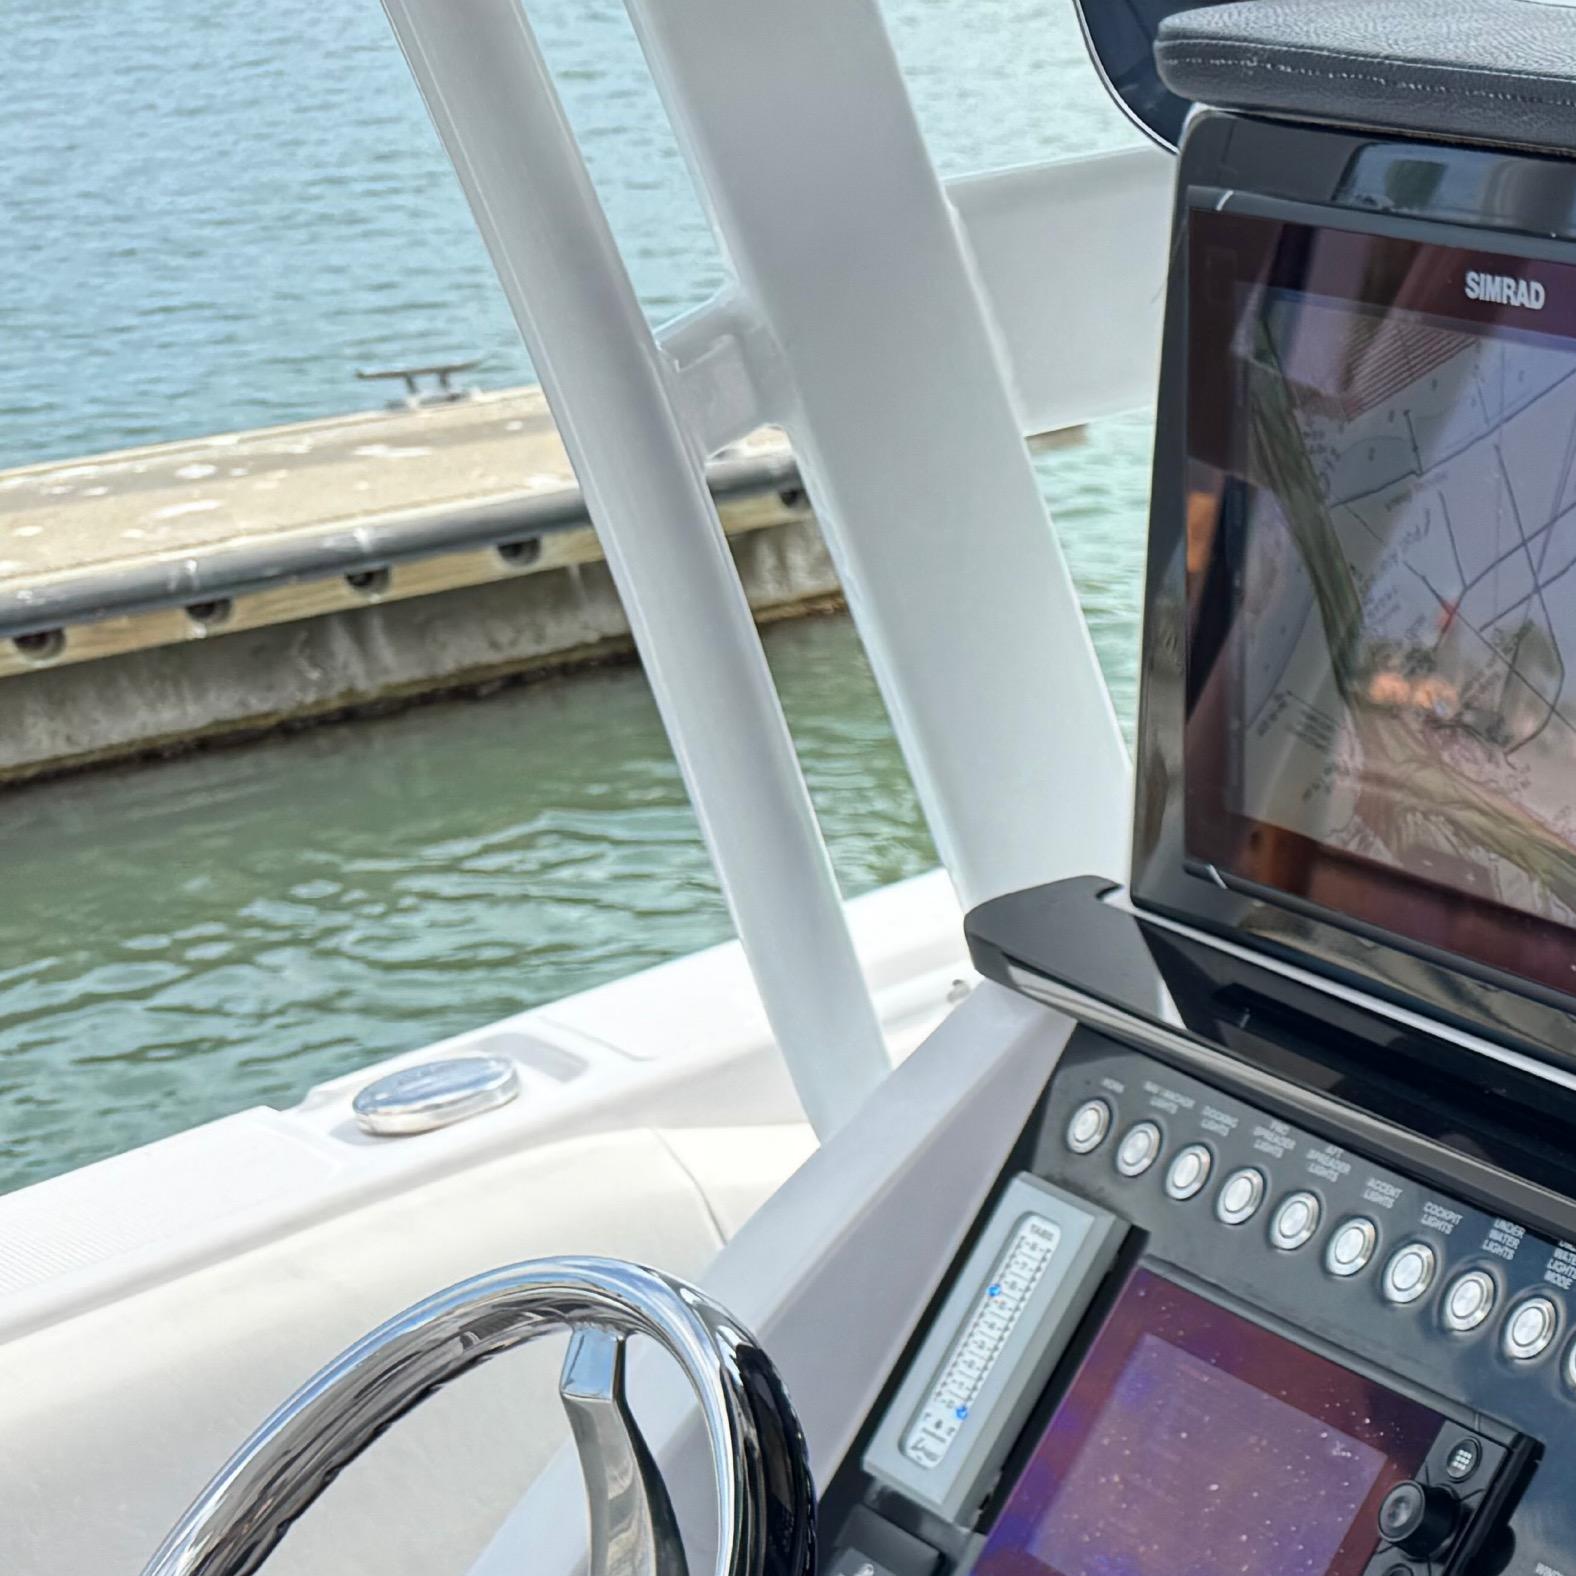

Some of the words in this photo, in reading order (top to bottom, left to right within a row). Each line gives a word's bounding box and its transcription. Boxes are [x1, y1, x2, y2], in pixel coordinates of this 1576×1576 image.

[1465, 271, 1545, 310] SIMRAD
[1366, 1177, 1403, 1198] ACCENT
[1363, 1189, 1396, 1209] LIGHTS
[1424, 1202, 1464, 1224] COCKPIT
[1420, 1215, 1454, 1235] LIGHTS
[1494, 1219, 1526, 1239] UNDER
[1489, 1229, 1520, 1250] WATER
[1482, 1240, 1515, 1261] LIGHTS
[1544, 1271, 1573, 1290] MODE
